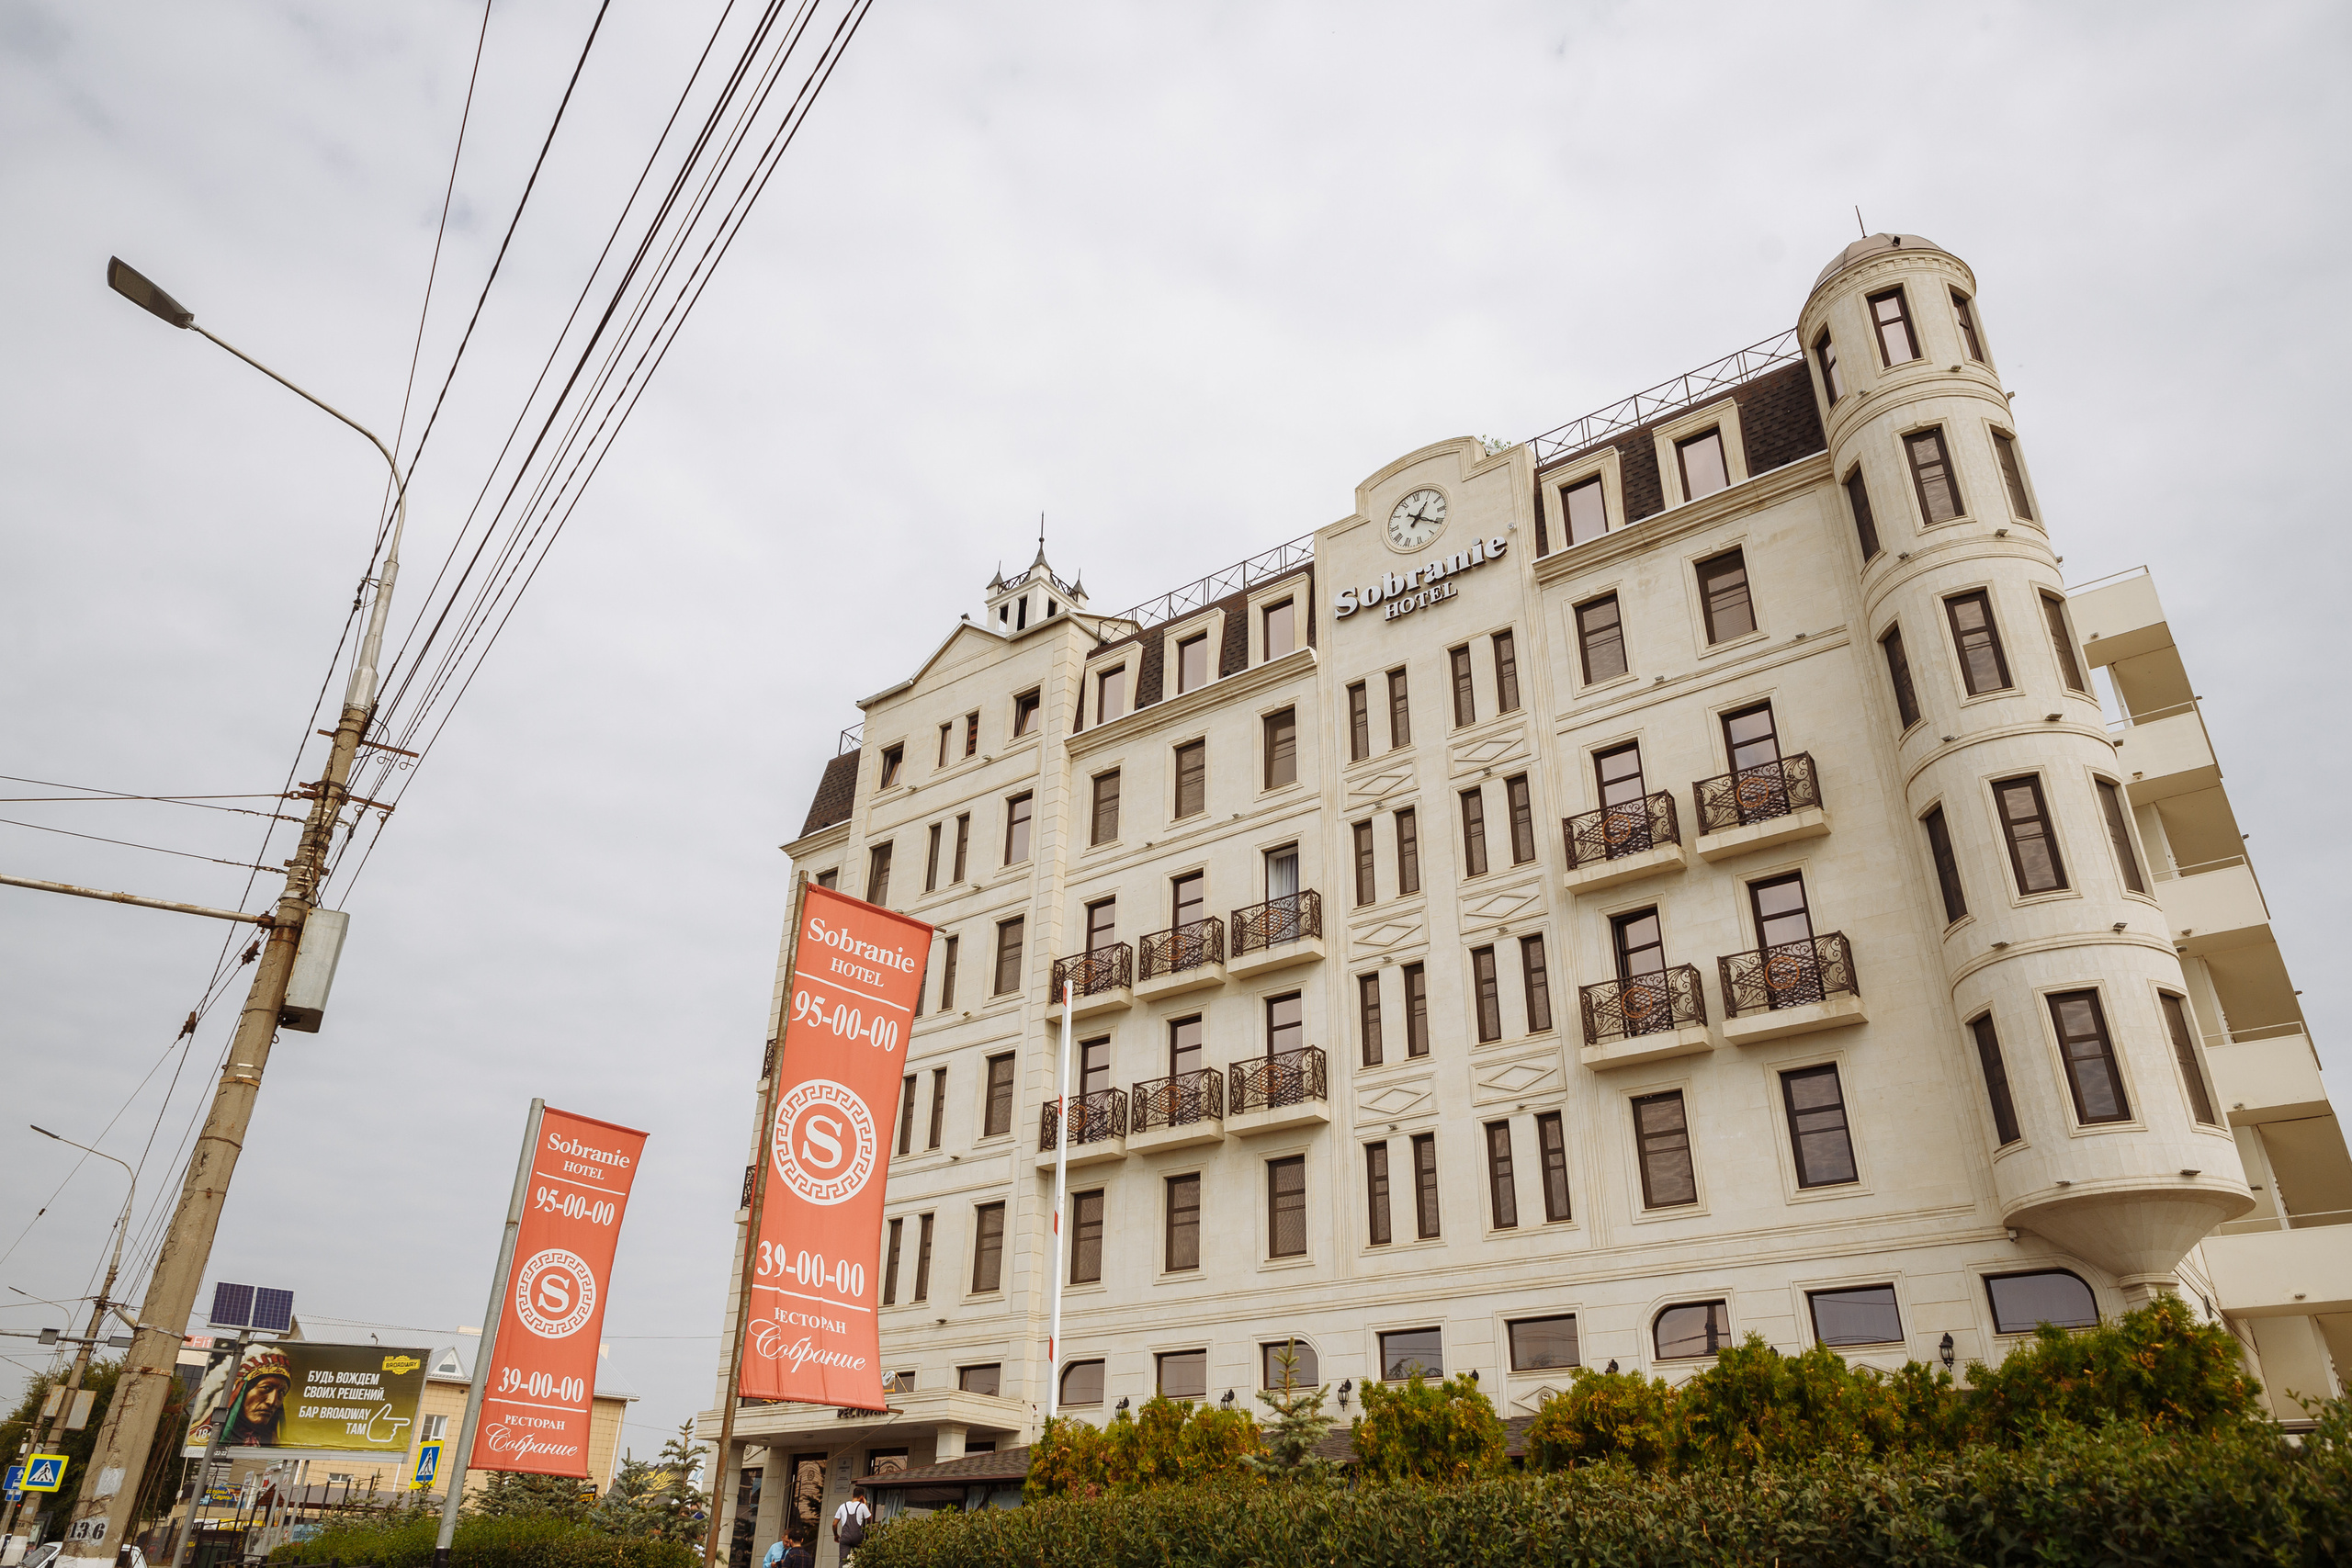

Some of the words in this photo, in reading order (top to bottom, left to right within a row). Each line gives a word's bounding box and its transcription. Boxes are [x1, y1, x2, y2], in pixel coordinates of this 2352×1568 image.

[1334, 536, 1508, 620] Sobranie
[1385, 581, 1458, 622] HOTEL
[807, 918, 915, 974] Sobranie
[830, 956, 885, 987] HOTEL
[791, 990, 899, 1052] 95-00-00
[548, 1132, 630, 1168] Sobranie
[801, 1113, 843, 1169] S
[563, 1160, 605, 1180] HOTEL
[534, 1186, 616, 1226] 95-00-00
[757, 1240, 865, 1297] 39-00-00
[537, 1274, 571, 1313] S
[749, 1318, 866, 1373] Собрание
[303, 1385, 336, 1399] СВОИХ
[337, 1387, 386, 1401] РЕШЕНИЙ.
[307, 1371, 334, 1384] БУДЬ
[335, 1371, 380, 1386] ВОЖДЕМ
[498, 1366, 584, 1403] 39-00-00
[299, 1405, 319, 1418] БАР
[319, 1406, 371, 1421] BROADWAY
[345, 1422, 368, 1435] ТАМ
[504, 1414, 566, 1430] РЕСТОРАН
[485, 1423, 578, 1461] Собрание
[70, 1521, 106, 1540] 136
